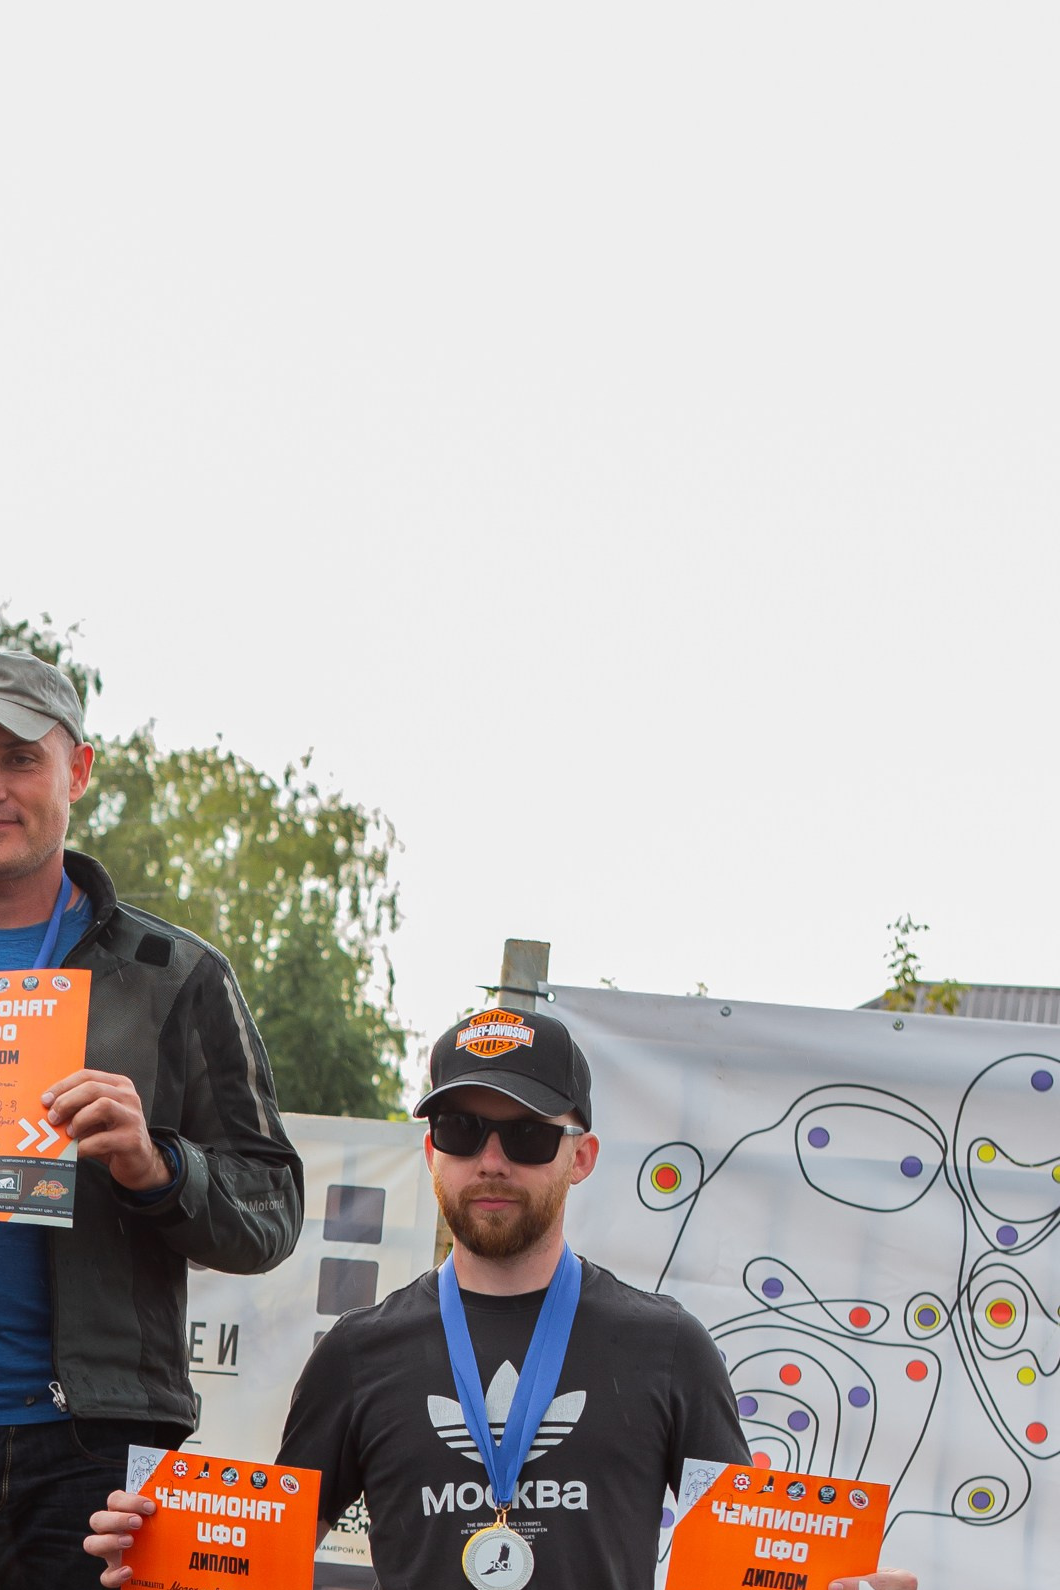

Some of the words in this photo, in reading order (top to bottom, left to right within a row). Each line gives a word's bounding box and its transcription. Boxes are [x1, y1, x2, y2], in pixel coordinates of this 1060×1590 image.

[460, 1024, 530, 1043] HARLEY-DAVIDSON
[155, 1485, 285, 1525] ЧЕМПИОНАТ
[709, 1500, 853, 1539] ЧЕМПИОНАТ
[196, 1520, 246, 1548] ЦФО
[754, 1536, 809, 1563] ЦФО
[189, 1550, 249, 1577] ДИПЛОМ
